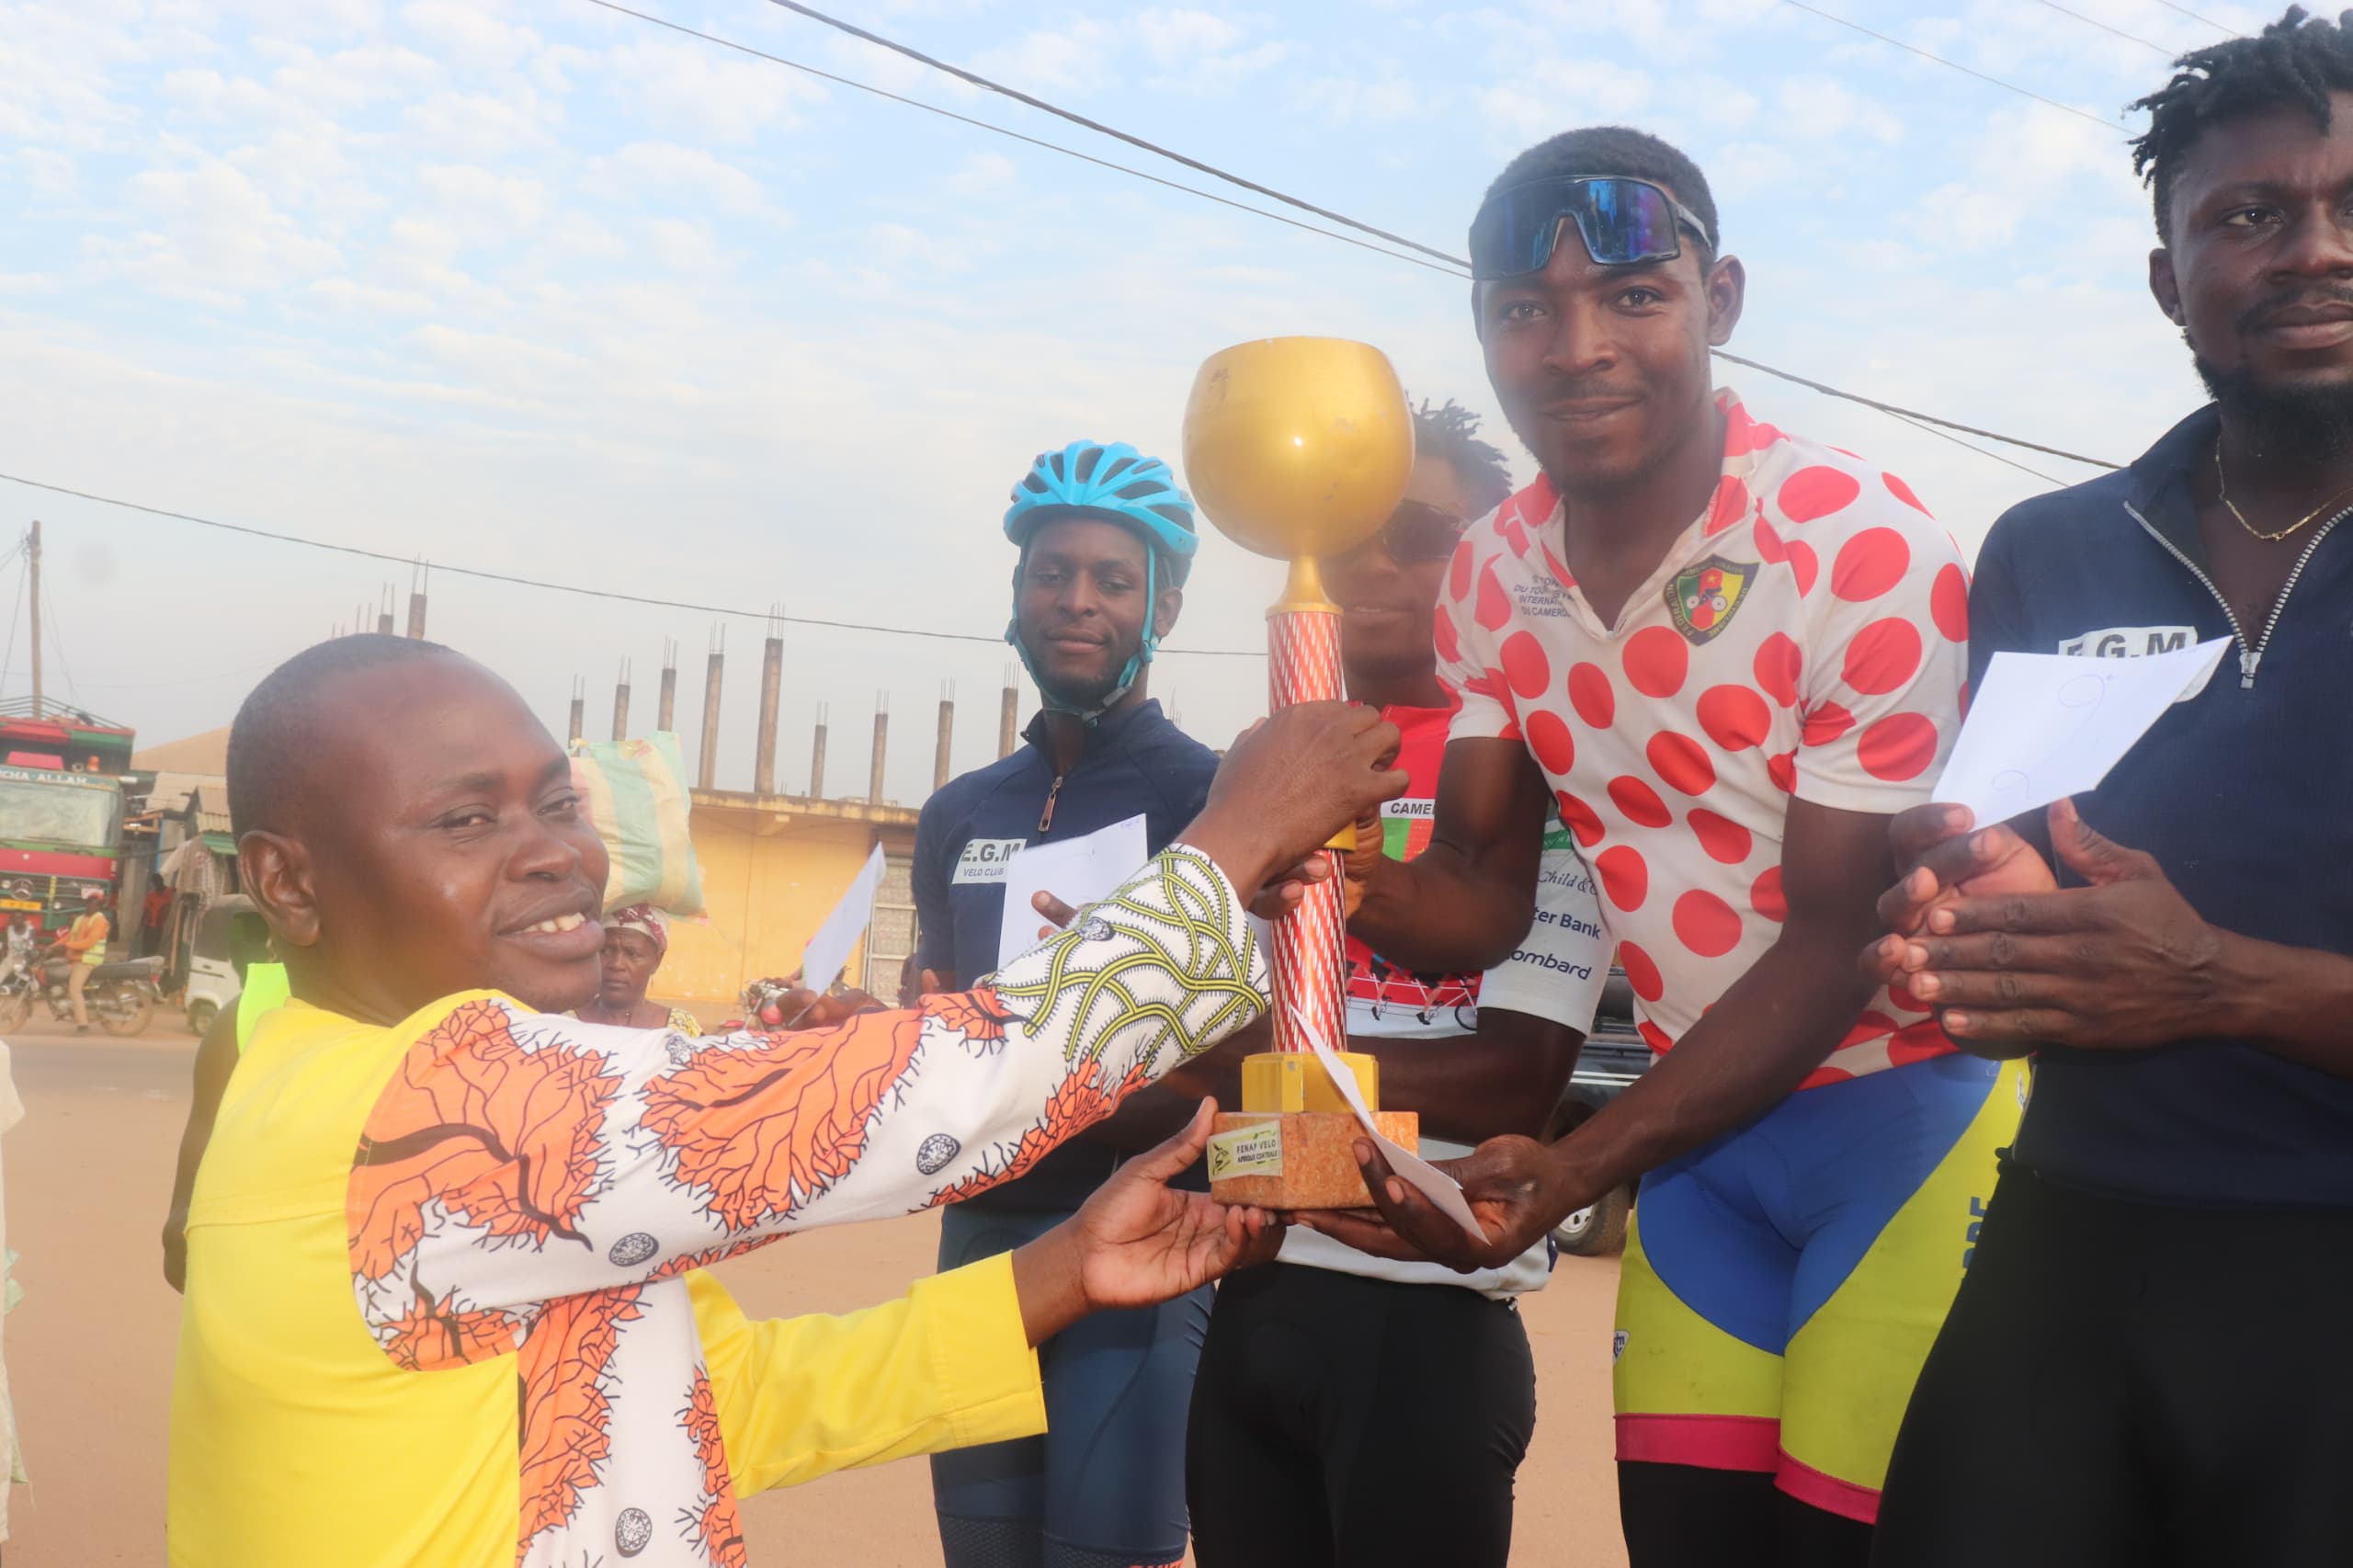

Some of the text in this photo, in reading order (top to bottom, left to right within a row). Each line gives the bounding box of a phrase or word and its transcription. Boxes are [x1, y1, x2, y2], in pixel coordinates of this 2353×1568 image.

[1390, 801, 1435, 815] CAME
[963, 868, 1005, 877] VELO CLUB
[1533, 906, 1601, 939] ter Bank
[1506, 949, 1592, 981] ombard
[1259, 1139, 1277, 1149] VELO
